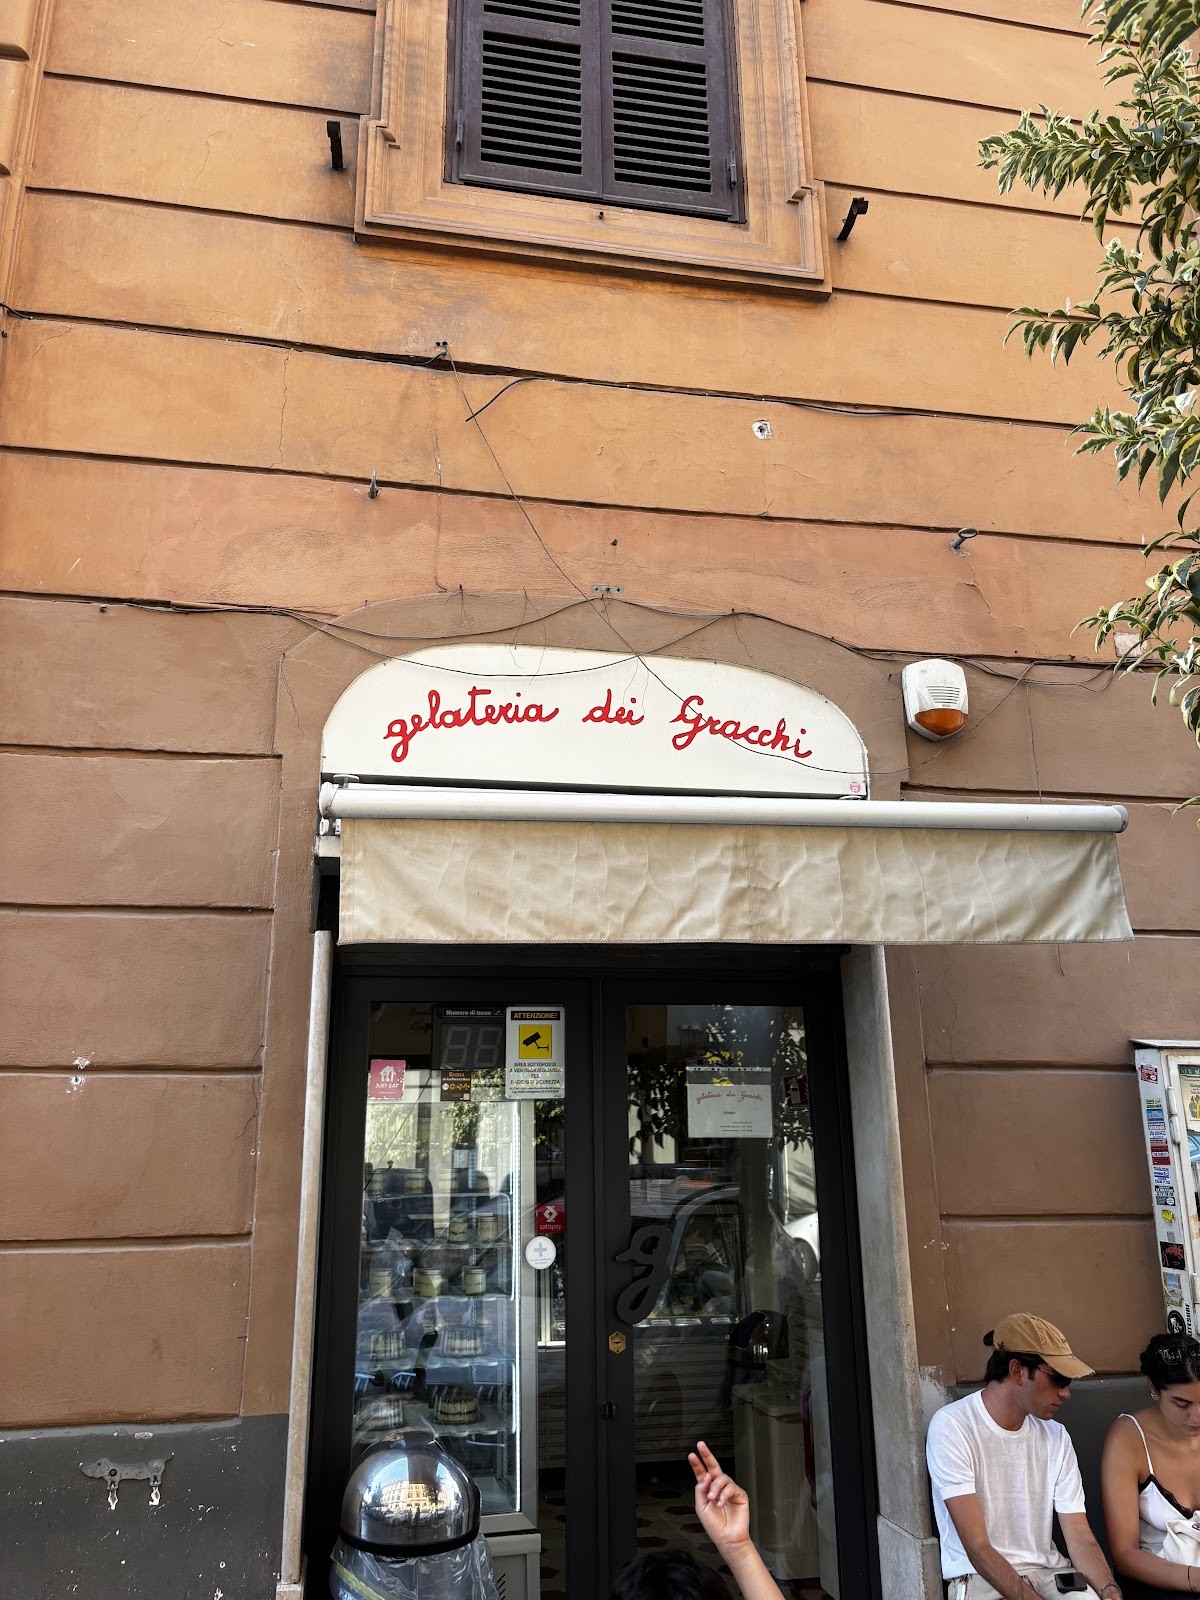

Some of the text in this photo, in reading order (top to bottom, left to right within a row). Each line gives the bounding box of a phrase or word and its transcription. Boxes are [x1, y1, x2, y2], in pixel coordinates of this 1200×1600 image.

[384, 685, 813, 762] gelateria dei Gracchi
[513, 1012, 558, 1020] ATTENZIONE!
[539, 1223, 562, 1231] satispay
